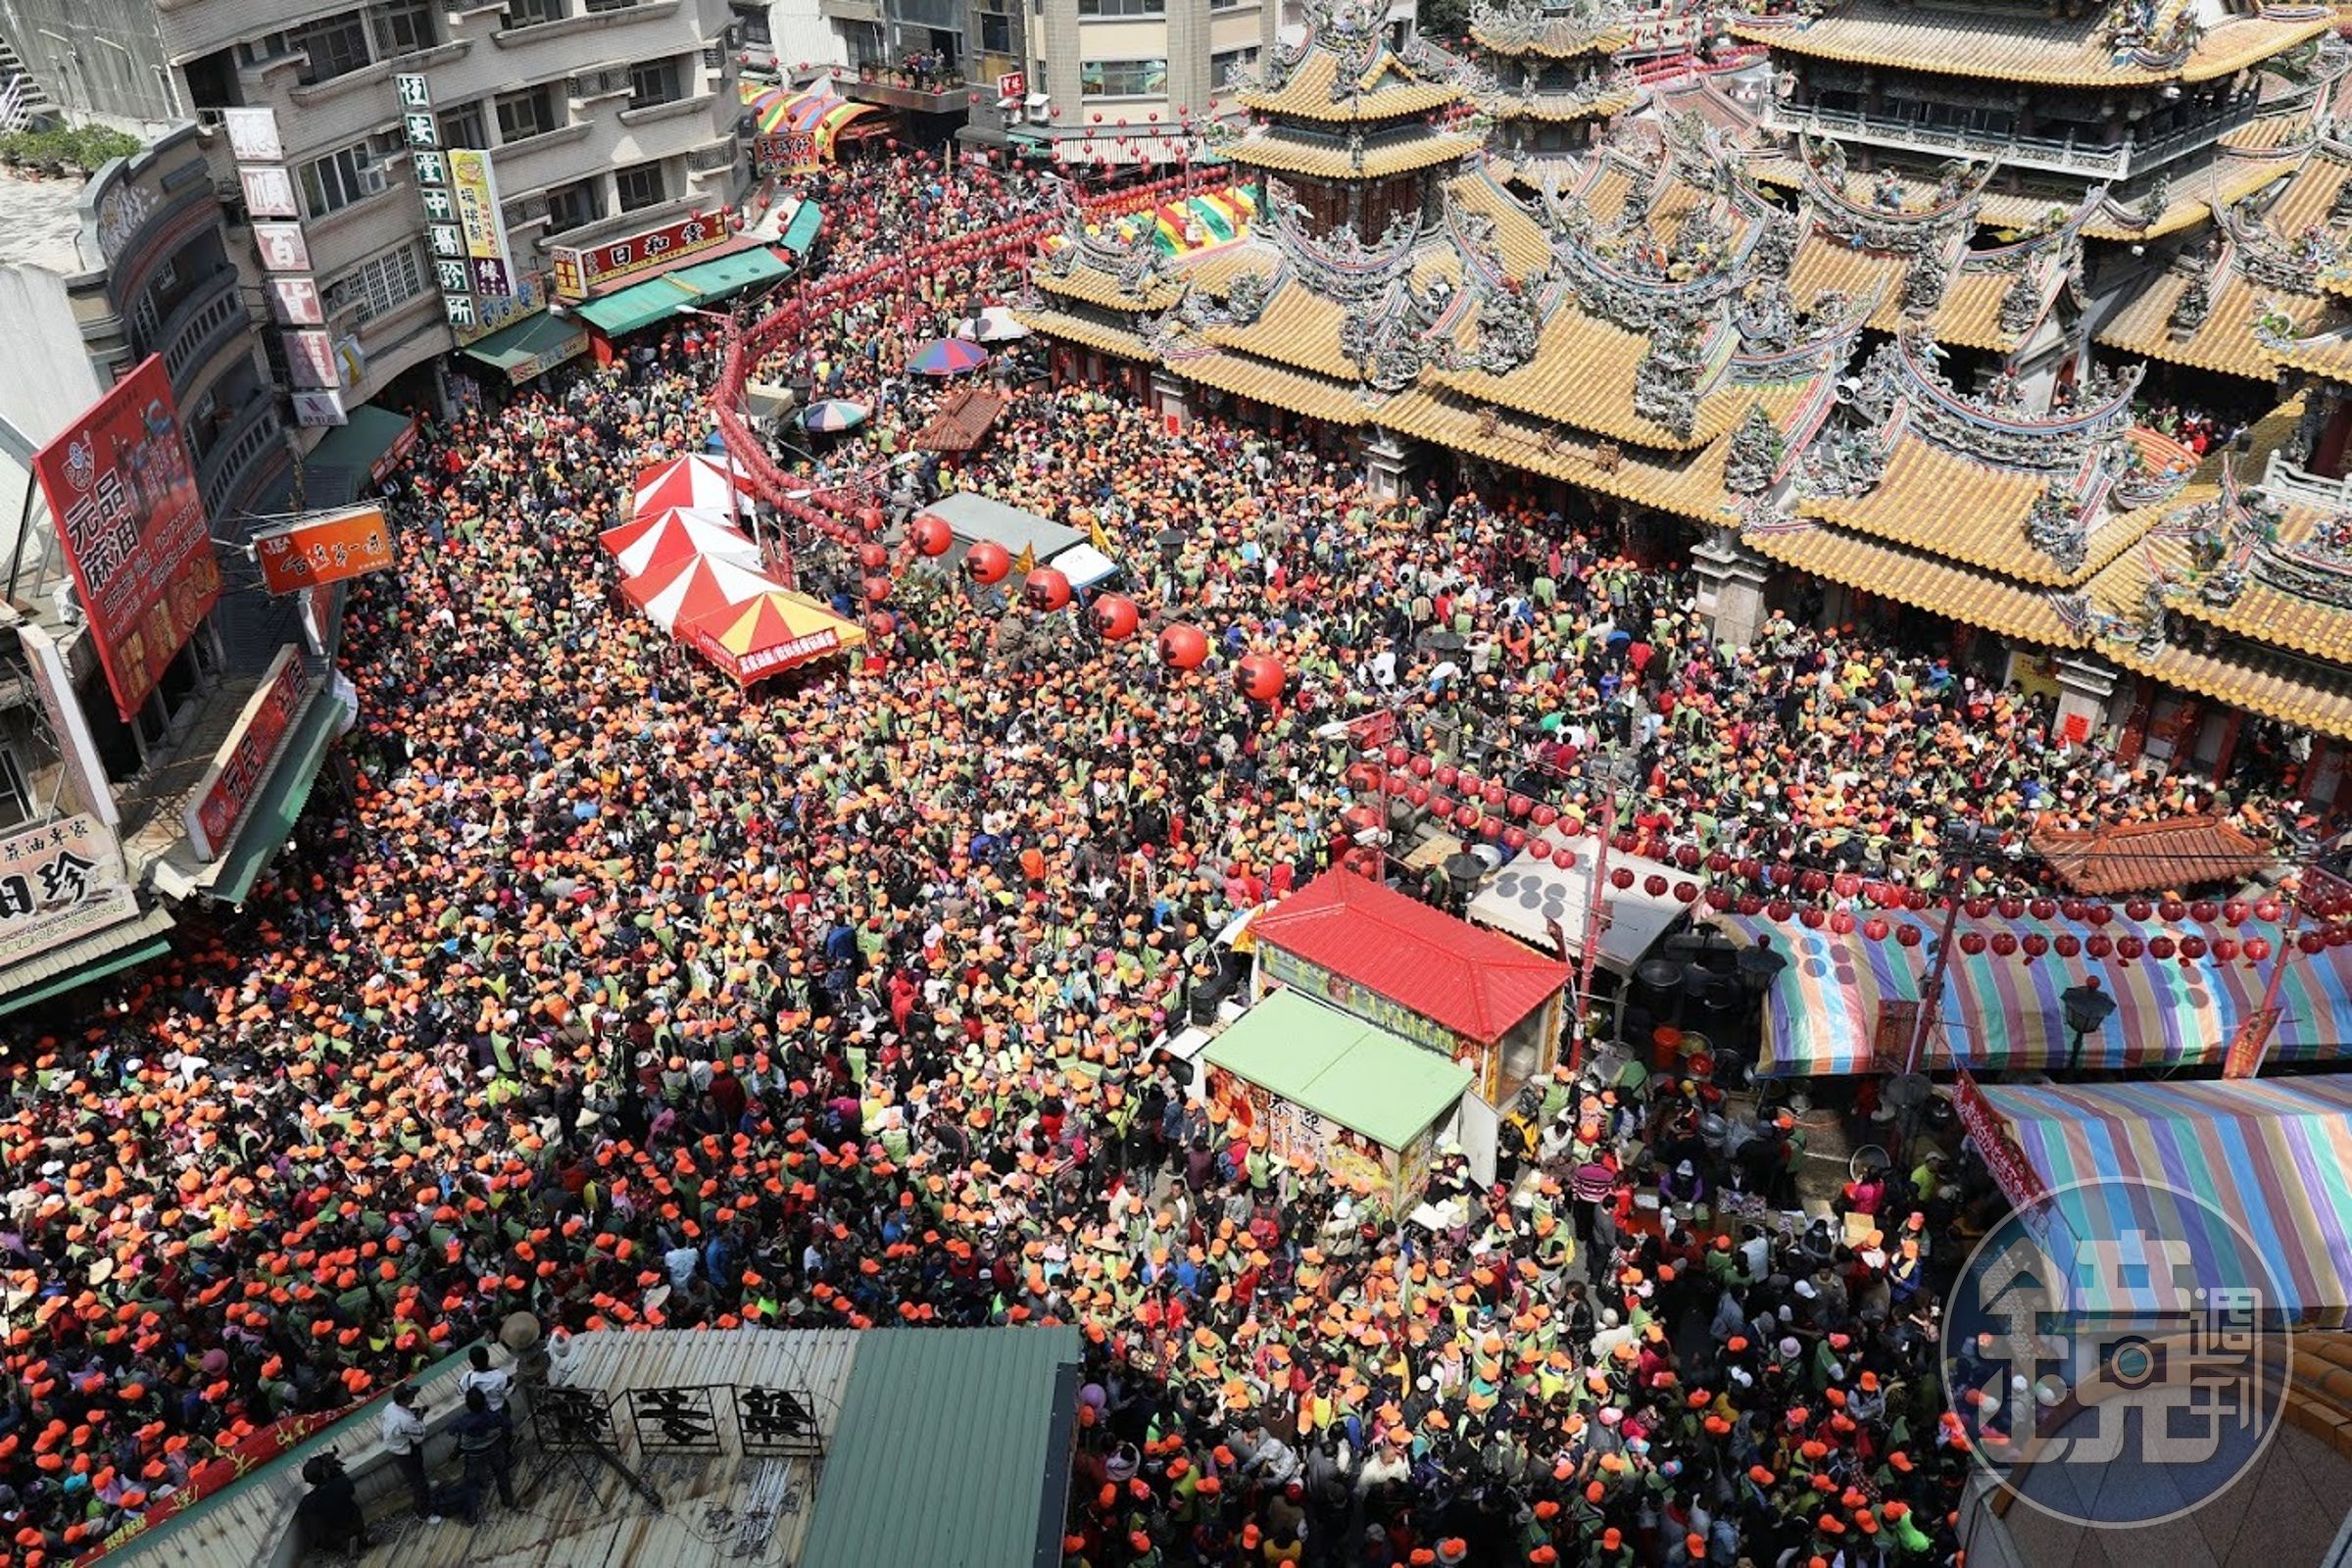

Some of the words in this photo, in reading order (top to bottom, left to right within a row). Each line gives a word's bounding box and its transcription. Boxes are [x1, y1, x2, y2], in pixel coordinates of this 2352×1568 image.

[611, 222, 707, 267] 日和堂
[64, 467, 128, 555] 元品
